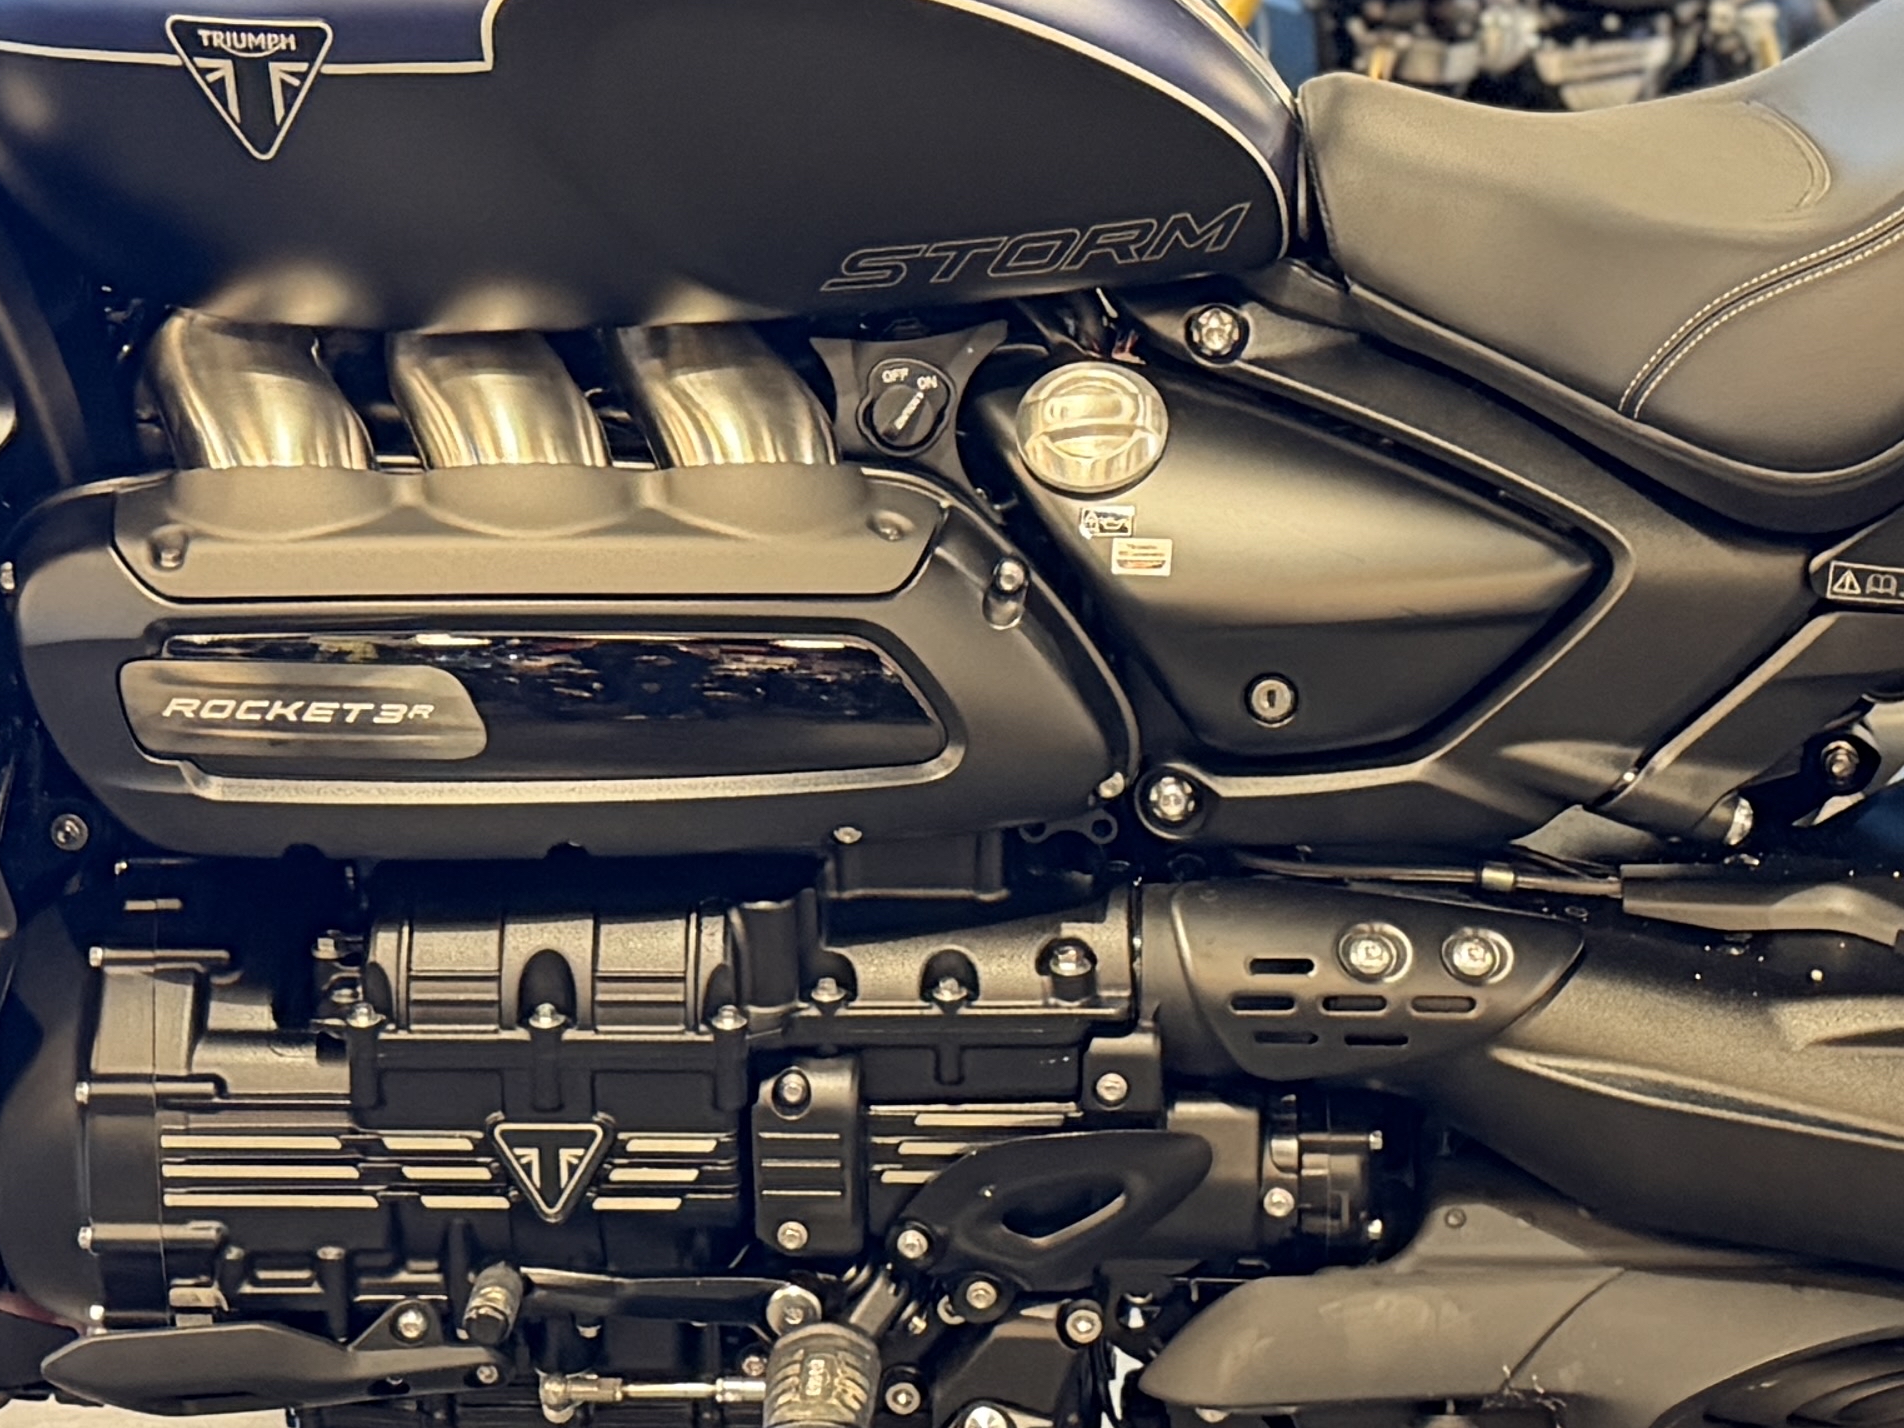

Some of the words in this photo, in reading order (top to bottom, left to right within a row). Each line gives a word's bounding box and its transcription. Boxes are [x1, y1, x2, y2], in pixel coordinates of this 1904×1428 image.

[197, 28, 297, 55] TRIUMPH
[820, 201, 1251, 291] STORM
[881, 367, 909, 383] OFF
[917, 375, 938, 390] ON
